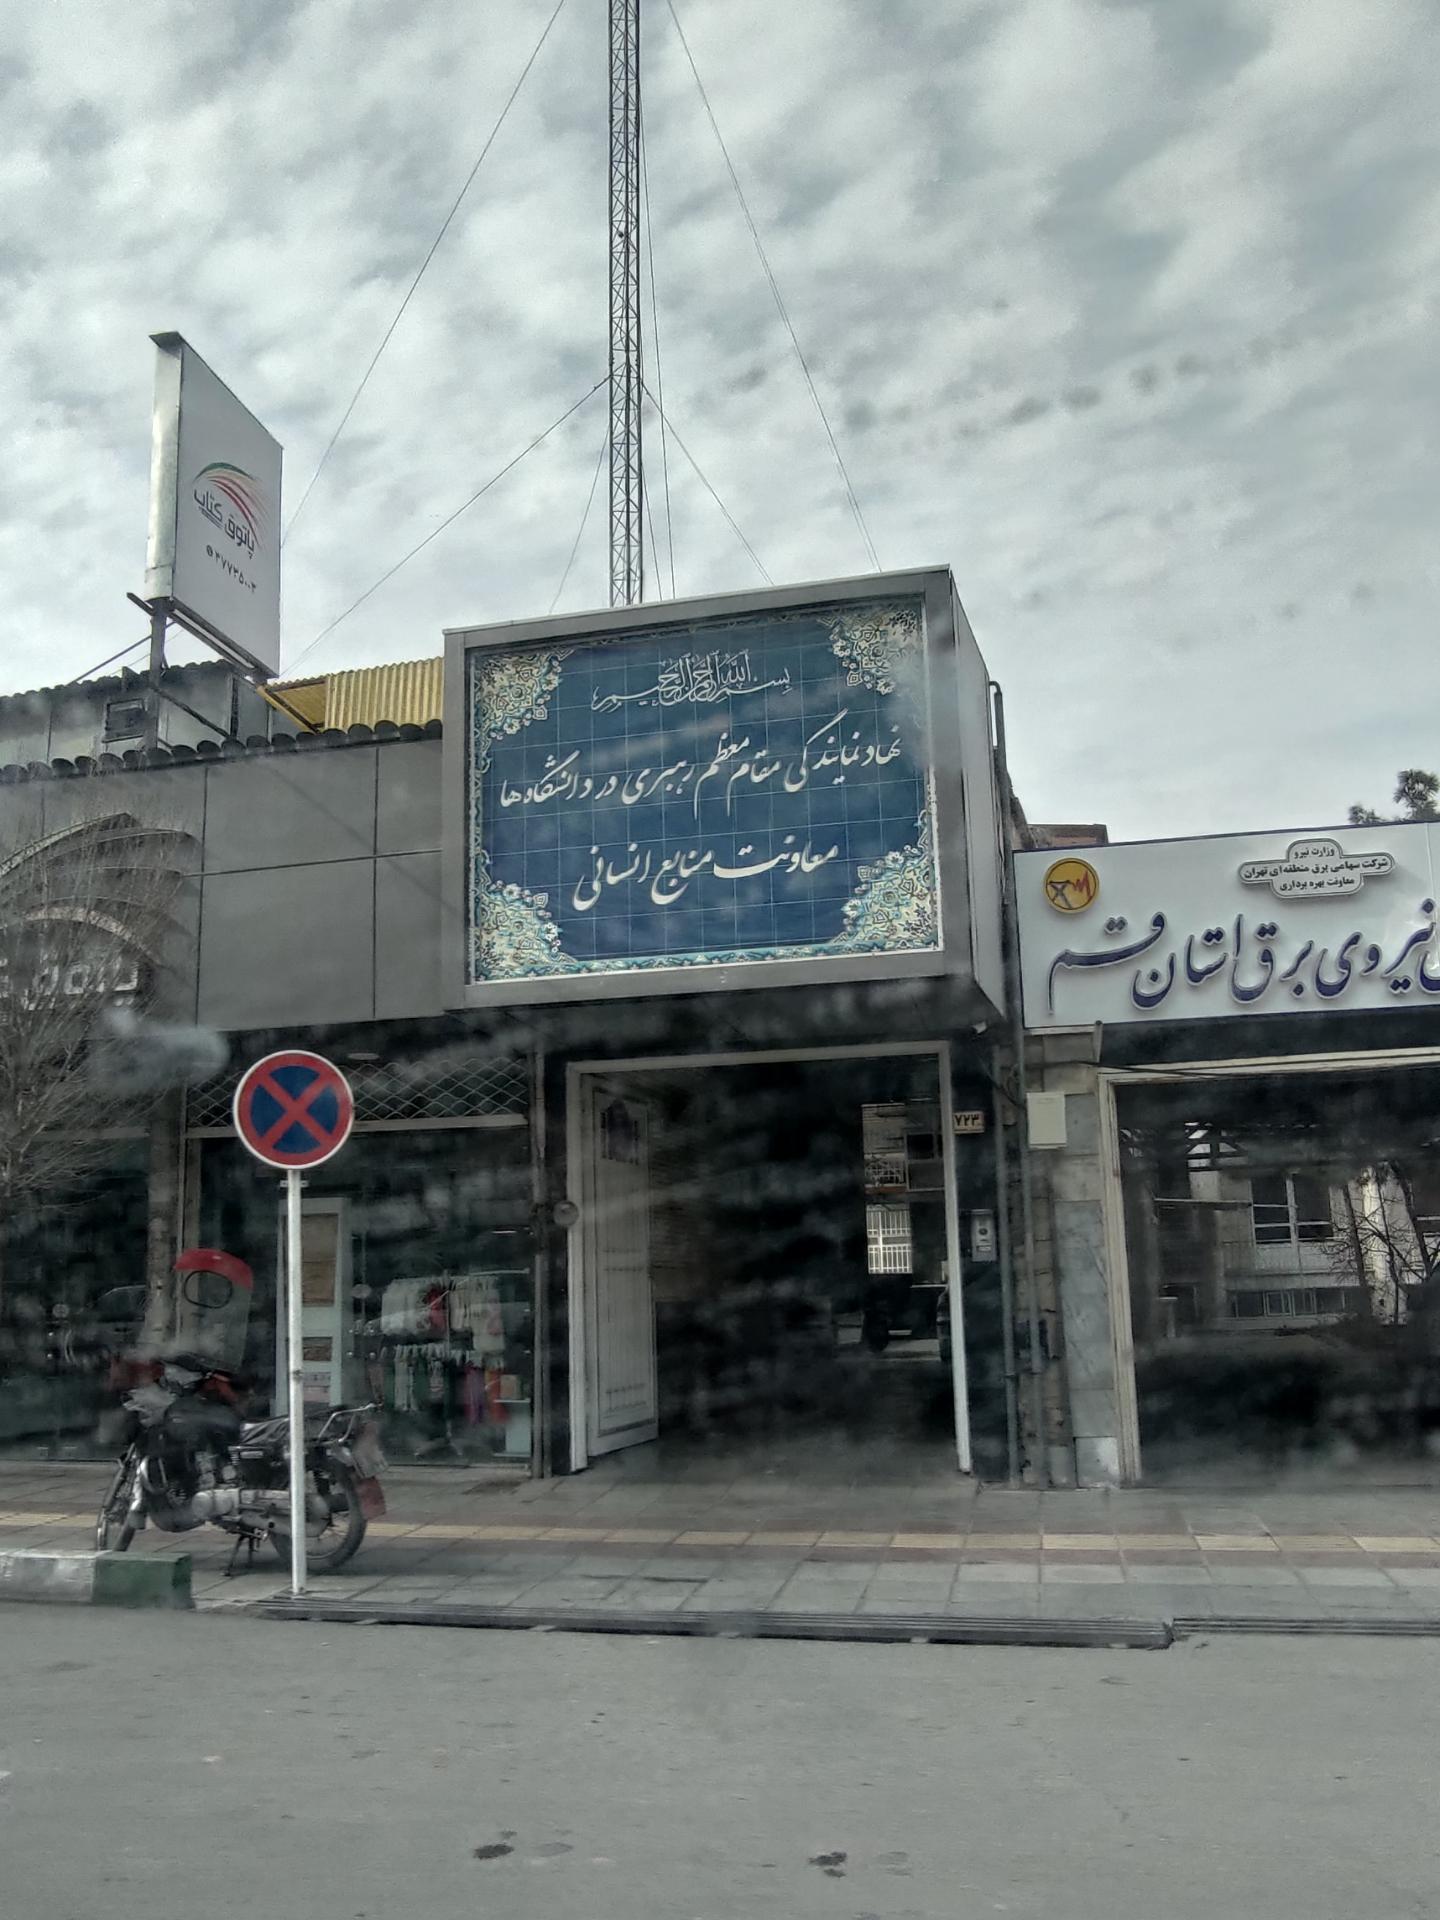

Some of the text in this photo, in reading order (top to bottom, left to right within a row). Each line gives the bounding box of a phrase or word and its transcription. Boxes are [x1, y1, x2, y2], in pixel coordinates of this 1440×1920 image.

[193, 489, 223, 523] کتاب
[225, 514, 255, 560] پاتوق
[784, 708, 860, 793] نمایندگی
[860, 725, 902, 767] نهاد
[594, 775, 618, 800] در
[622, 759, 695, 805] رهبری
[692, 732, 751, 821] معظم
[726, 749, 783, 817] مقام
[573, 835, 839, 911] معاونت منابع انسانی
[1244, 867, 1268, 879] تهران
[1293, 846, 1336, 860] وزارت نیرو
[1310, 864, 1329, 875] برق
[1330, 860, 1360, 873] سهامی
[1361, 856, 1389, 870] شرکت
[1279, 880, 1307, 892] برداری
[1327, 876, 1355, 888] معاونت
[1048, 911, 1166, 1014] قم
[1130, 913, 1243, 1010] استان
[1231, 921, 1314, 1003] برق
[1315, 898, 1437, 999] نیروی
[954, 1113, 980, 1127] ۷۲۳
